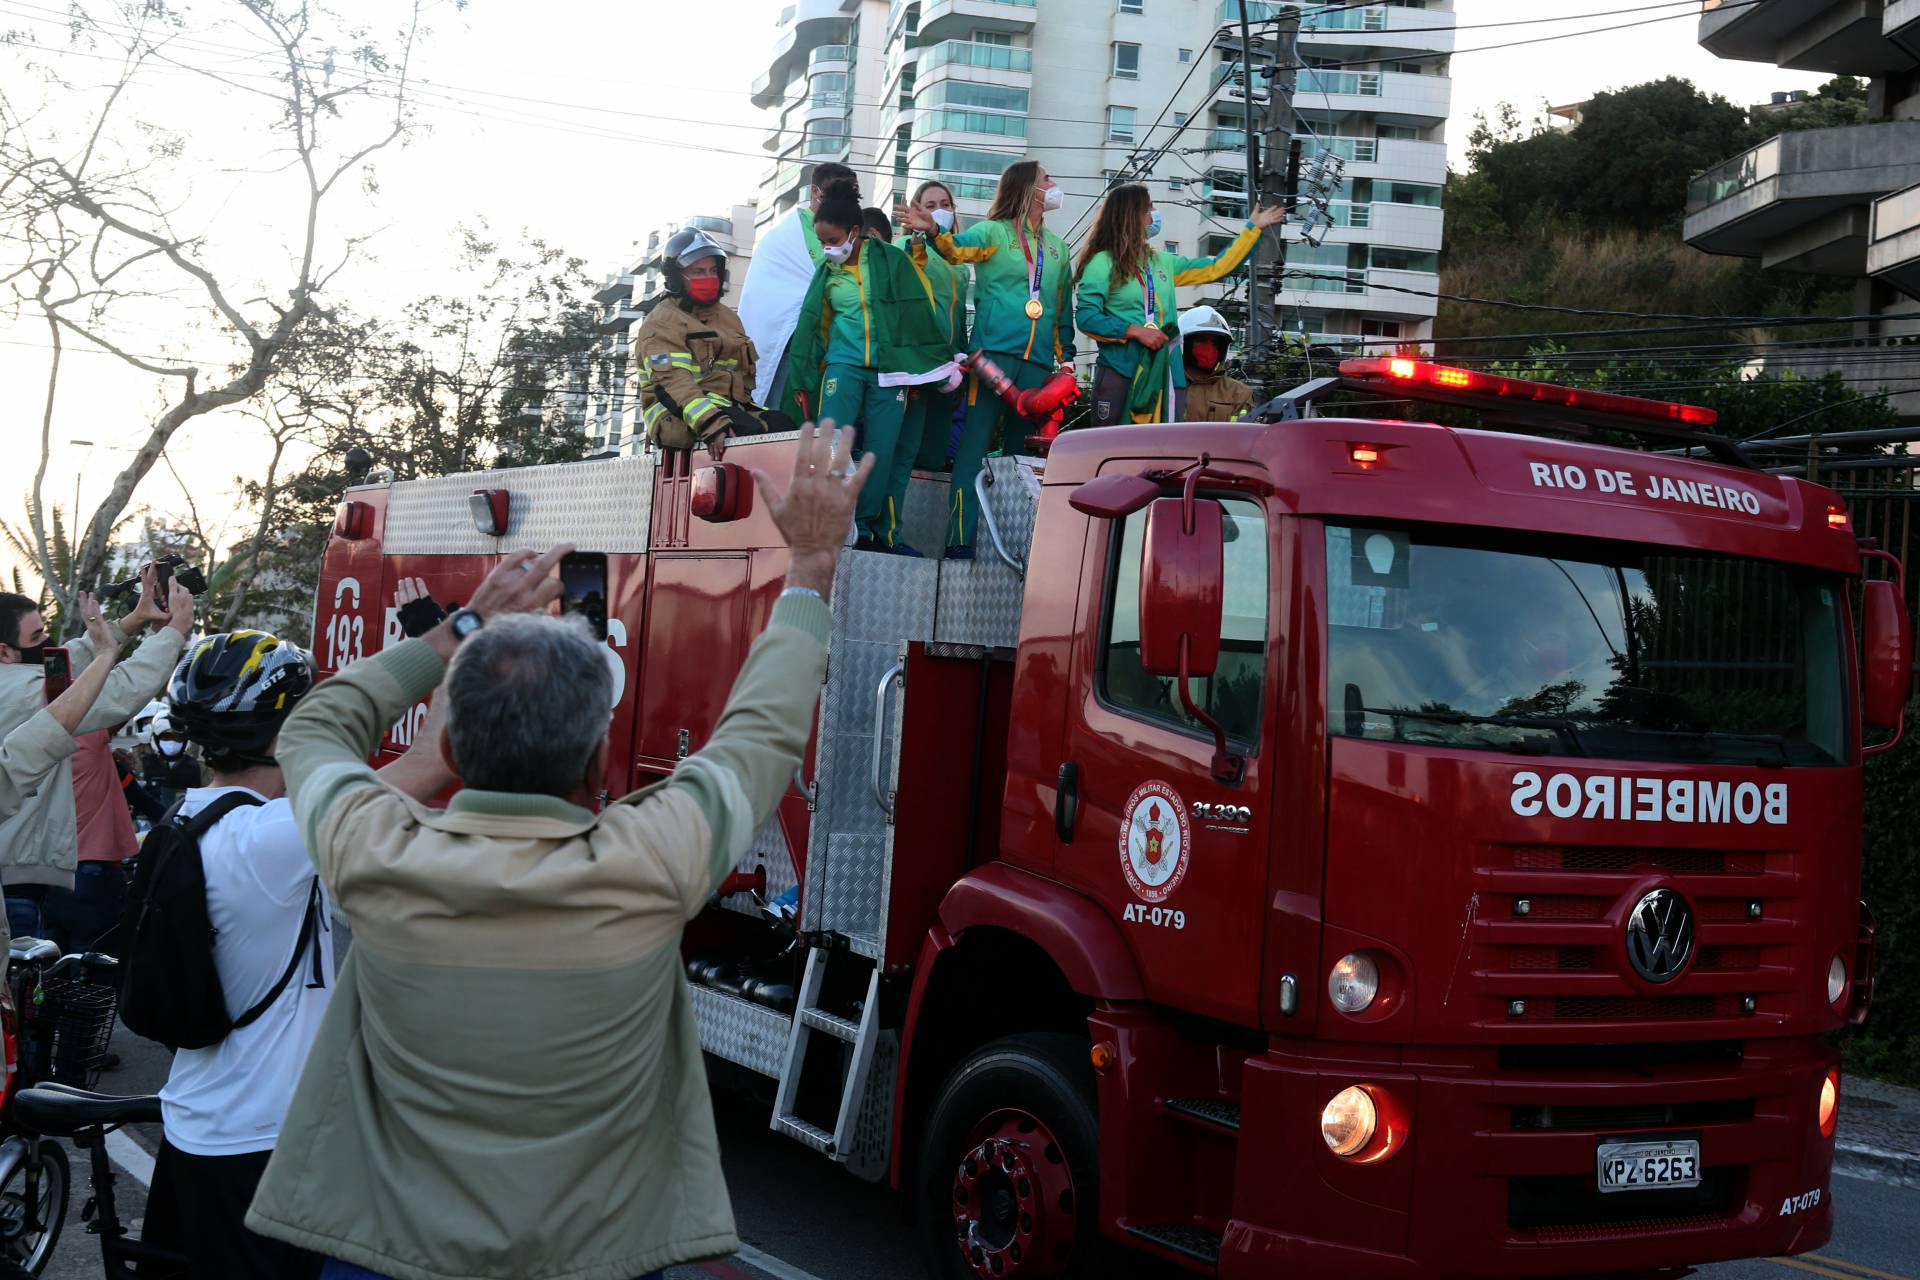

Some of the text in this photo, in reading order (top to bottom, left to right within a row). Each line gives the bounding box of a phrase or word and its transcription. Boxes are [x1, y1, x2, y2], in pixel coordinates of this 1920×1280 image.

[1529, 462, 1761, 516] RIO DE JANEIRO
[326, 613, 364, 672] 193
[261, 667, 286, 692] GTS
[1138, 784, 1161, 797] MILITAR
[1161, 786, 1182, 812] ESTADO
[1179, 812, 1187, 827] DO
[1124, 863, 1141, 890] CORPO
[1162, 863, 1183, 895] JANEIRO
[1123, 903, 1185, 929] AT-079
[1779, 1188, 1821, 1217] AT-079
